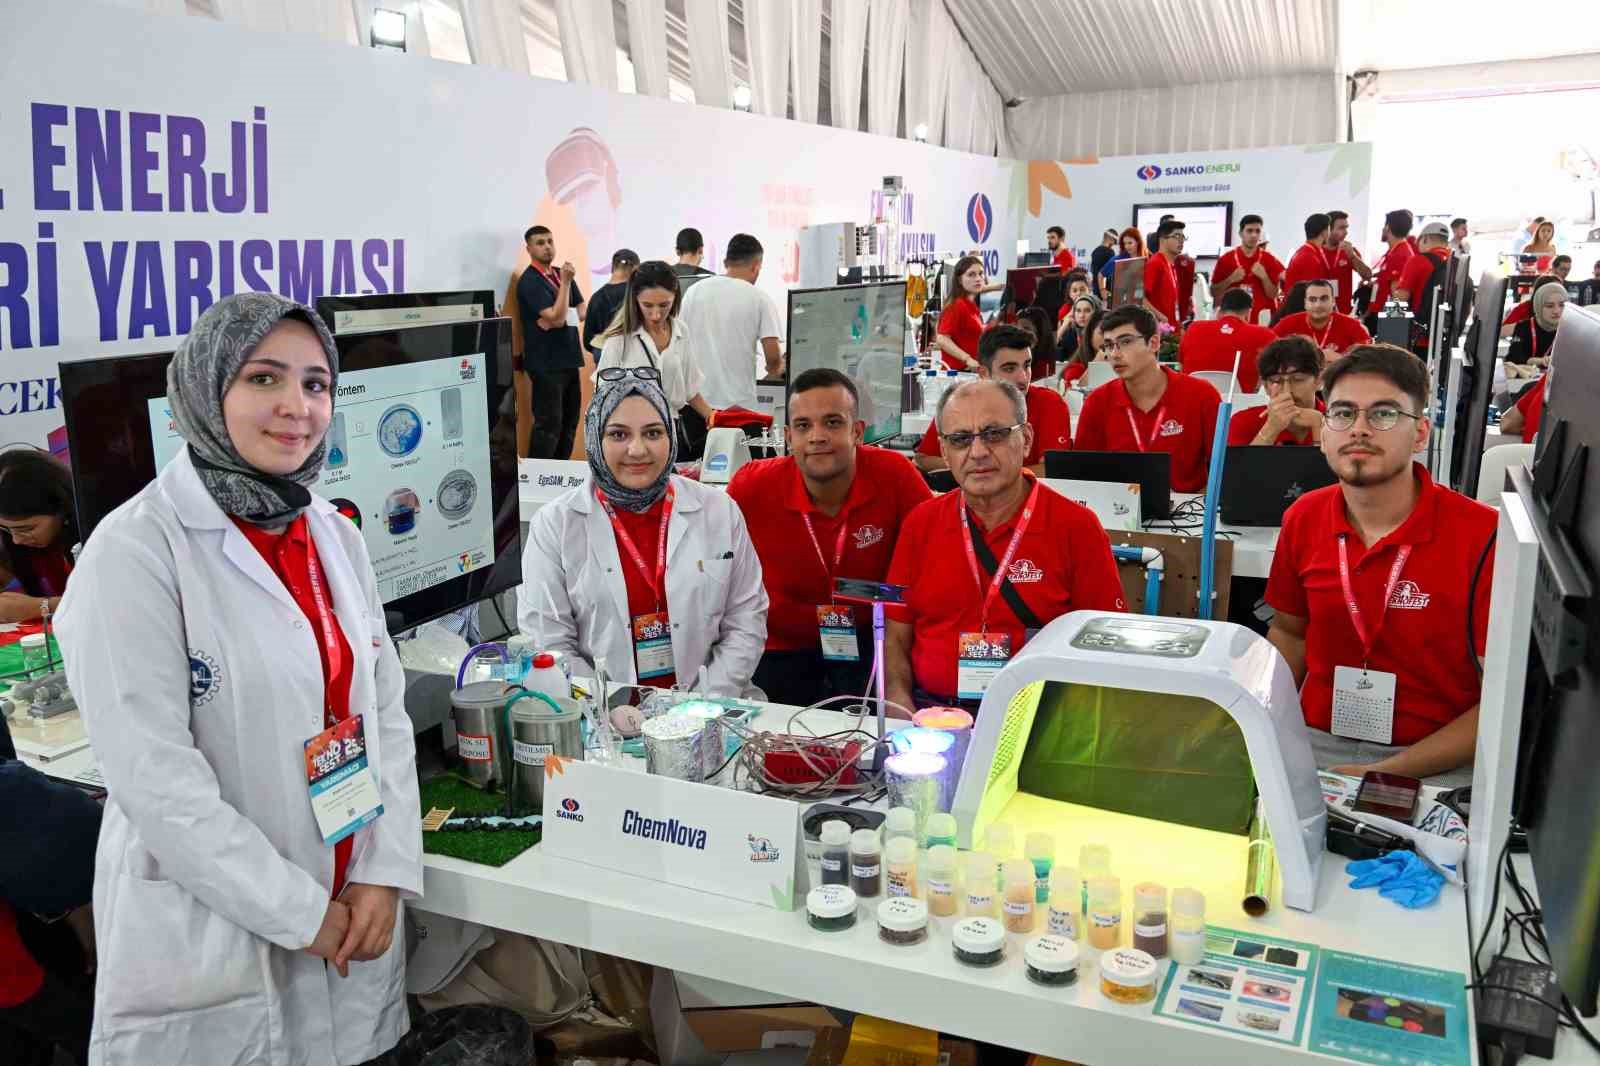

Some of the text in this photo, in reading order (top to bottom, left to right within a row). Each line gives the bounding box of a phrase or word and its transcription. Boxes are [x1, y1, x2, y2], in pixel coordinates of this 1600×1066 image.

[31, 102, 269, 214] ENERJİ
[1165, 165, 1204, 177] SANKO
[334, 383, 366, 398] öntem
[555, 809, 584, 823] SANKO
[622, 808, 708, 851] ChemNova
